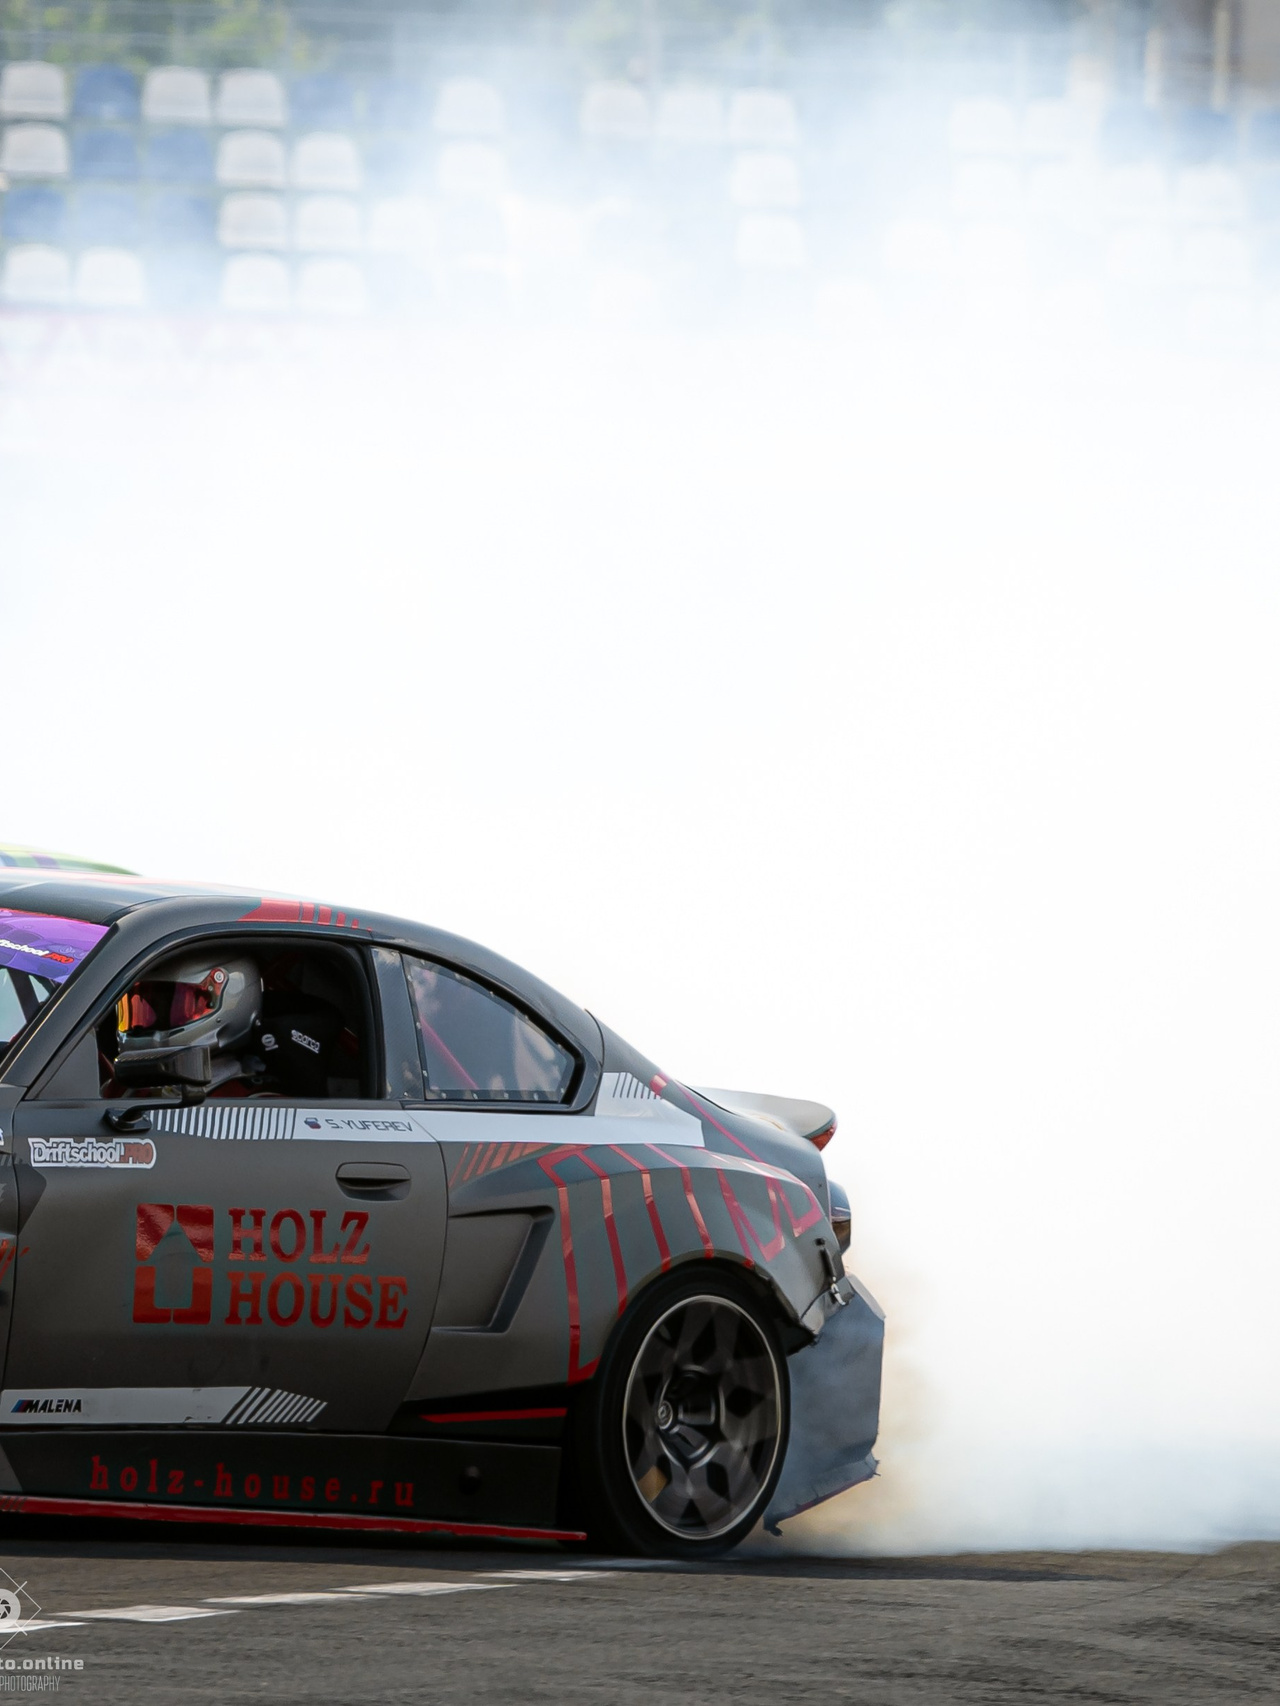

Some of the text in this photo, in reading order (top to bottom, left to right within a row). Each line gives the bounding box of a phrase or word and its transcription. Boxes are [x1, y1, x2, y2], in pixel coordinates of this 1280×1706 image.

[291, 1029, 320, 1052] sparco
[229, 1207, 371, 1265] HOLZ
[225, 1272, 409, 1330] HOUSE
[24, 1398, 83, 1414] MALENA
[89, 1455, 416, 1507] holz-house.ru
